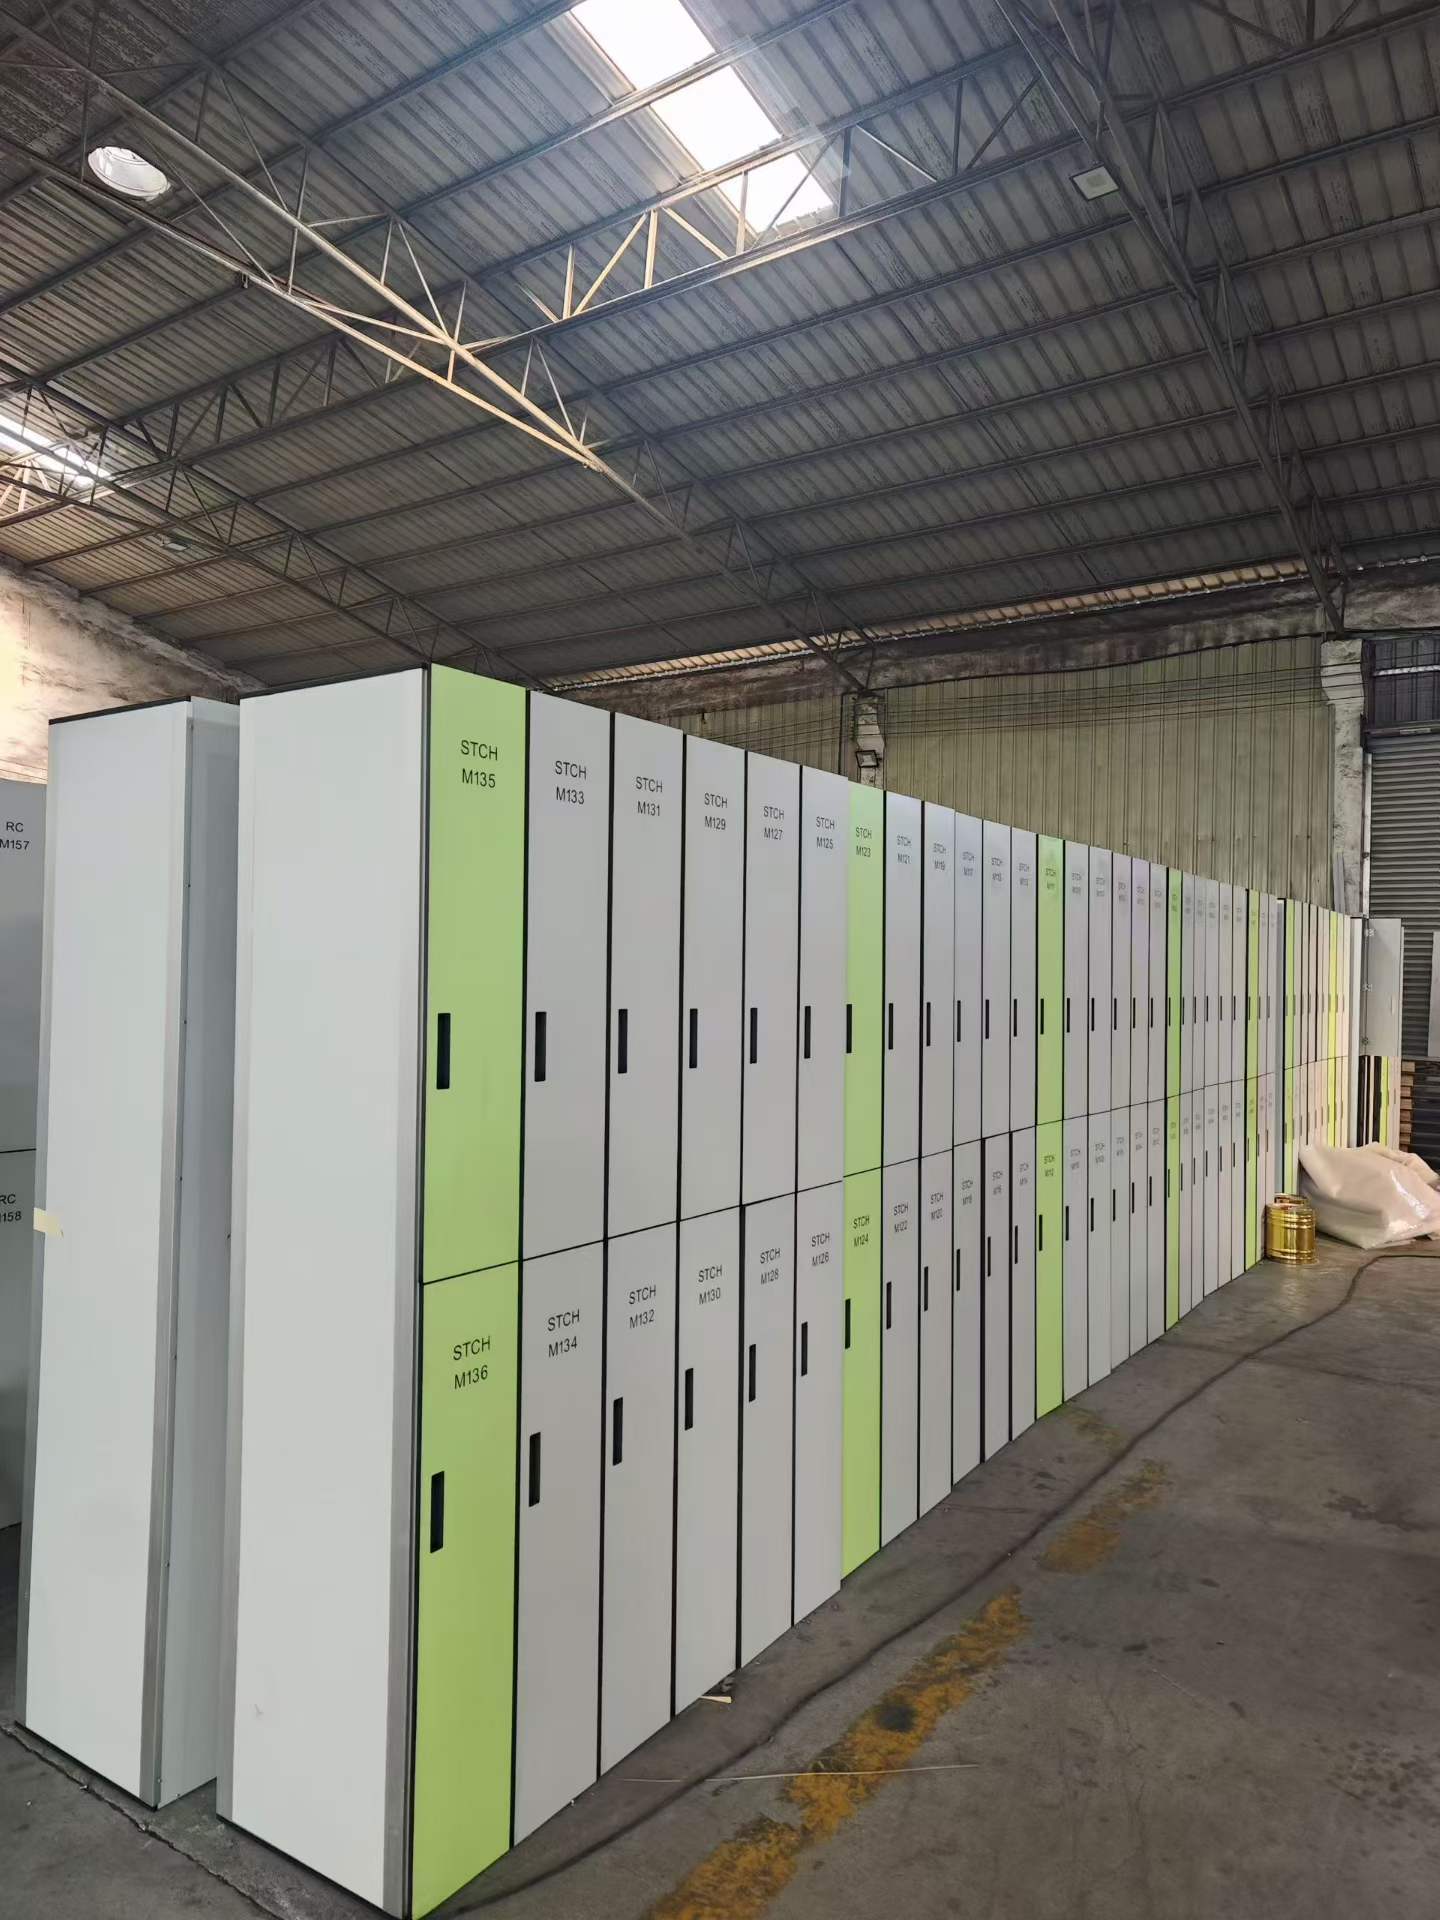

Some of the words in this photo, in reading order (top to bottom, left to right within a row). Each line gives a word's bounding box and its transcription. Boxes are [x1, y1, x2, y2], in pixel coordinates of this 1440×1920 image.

[460, 739, 498, 761] STCH
[461, 767, 496, 789] M135
[554, 760, 587, 780] STCH
[635, 775, 663, 793] STCH
[555, 785, 585, 805] M133
[704, 792, 728, 809] STCH
[637, 800, 661, 817] M131
[763, 805, 785, 820] STCH
[5, 821, 24, 833] RC
[704, 815, 727, 831] M129
[815, 815, 835, 830] STCH
[763, 826, 784, 841] M127
[855, 826, 873, 840] STCH
[896, 834, 912, 848] STCH
[0, 838, 30, 851] M157
[816, 836, 834, 850] M125
[855, 845, 871, 858] M123
[0, 1193, 17, 1205] RC
[0, 1210, 22, 1223] 158
[893, 1202, 909, 1217] STCH
[852, 1215, 870, 1230] STCH
[811, 1231, 831, 1248] STCH
[853, 1232, 869, 1248] M124
[759, 1247, 781, 1265] STCH
[811, 1251, 830, 1267] M126
[697, 1264, 723, 1283] STCH
[760, 1267, 780, 1285] M128
[628, 1285, 657, 1305] STCH
[698, 1287, 721, 1305] M130
[547, 1308, 580, 1332] STCH
[629, 1308, 655, 1329] M132
[452, 1335, 491, 1361] STCH
[548, 1335, 578, 1358] M134
[454, 1364, 489, 1390] M136
